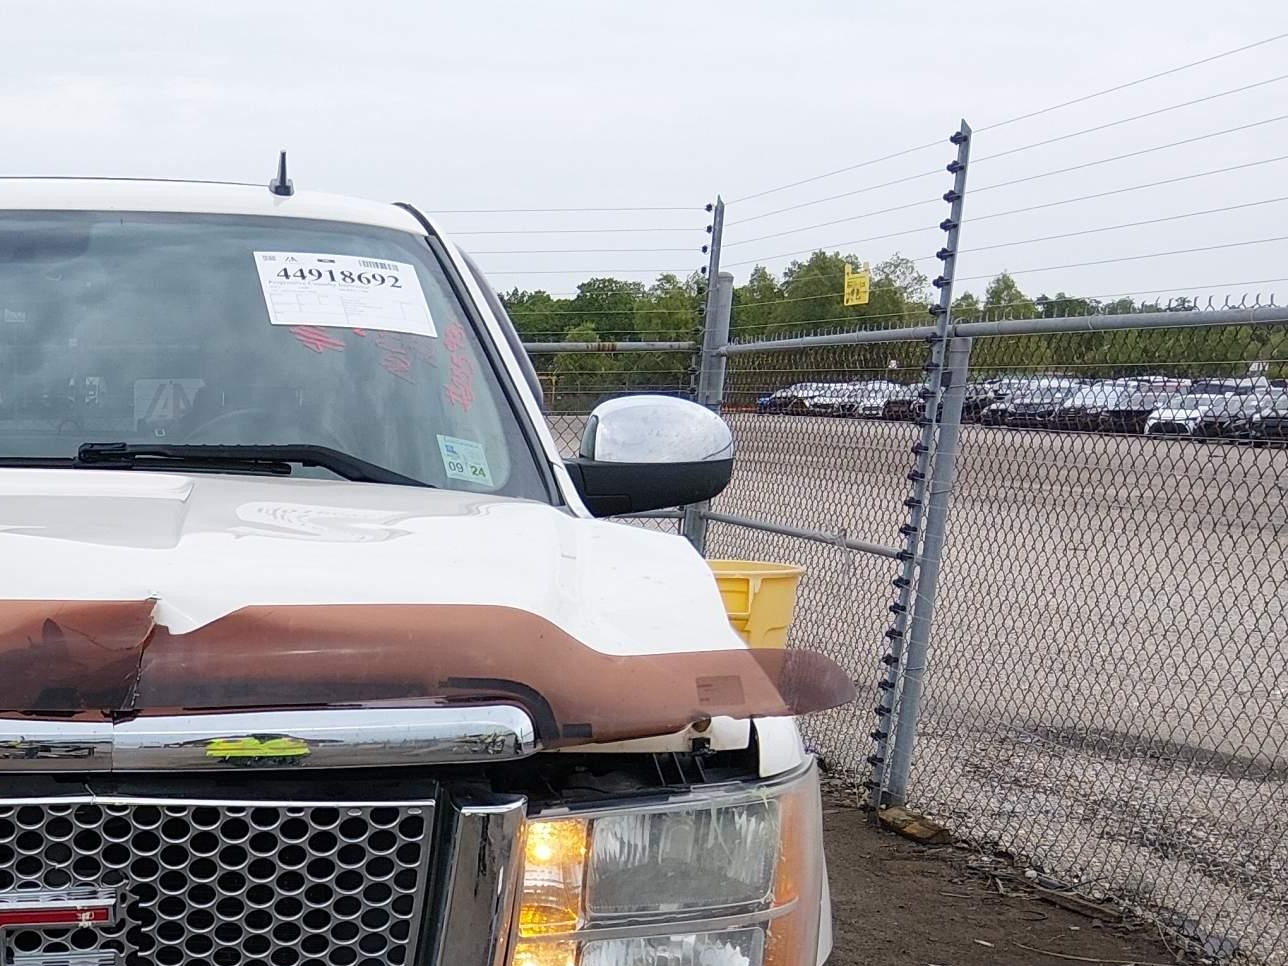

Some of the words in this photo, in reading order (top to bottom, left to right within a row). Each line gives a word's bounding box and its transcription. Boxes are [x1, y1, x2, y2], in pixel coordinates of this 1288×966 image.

[276, 267, 402, 289] 44918692
[448, 461, 464, 473] 09
[470, 465, 487, 478] 24
